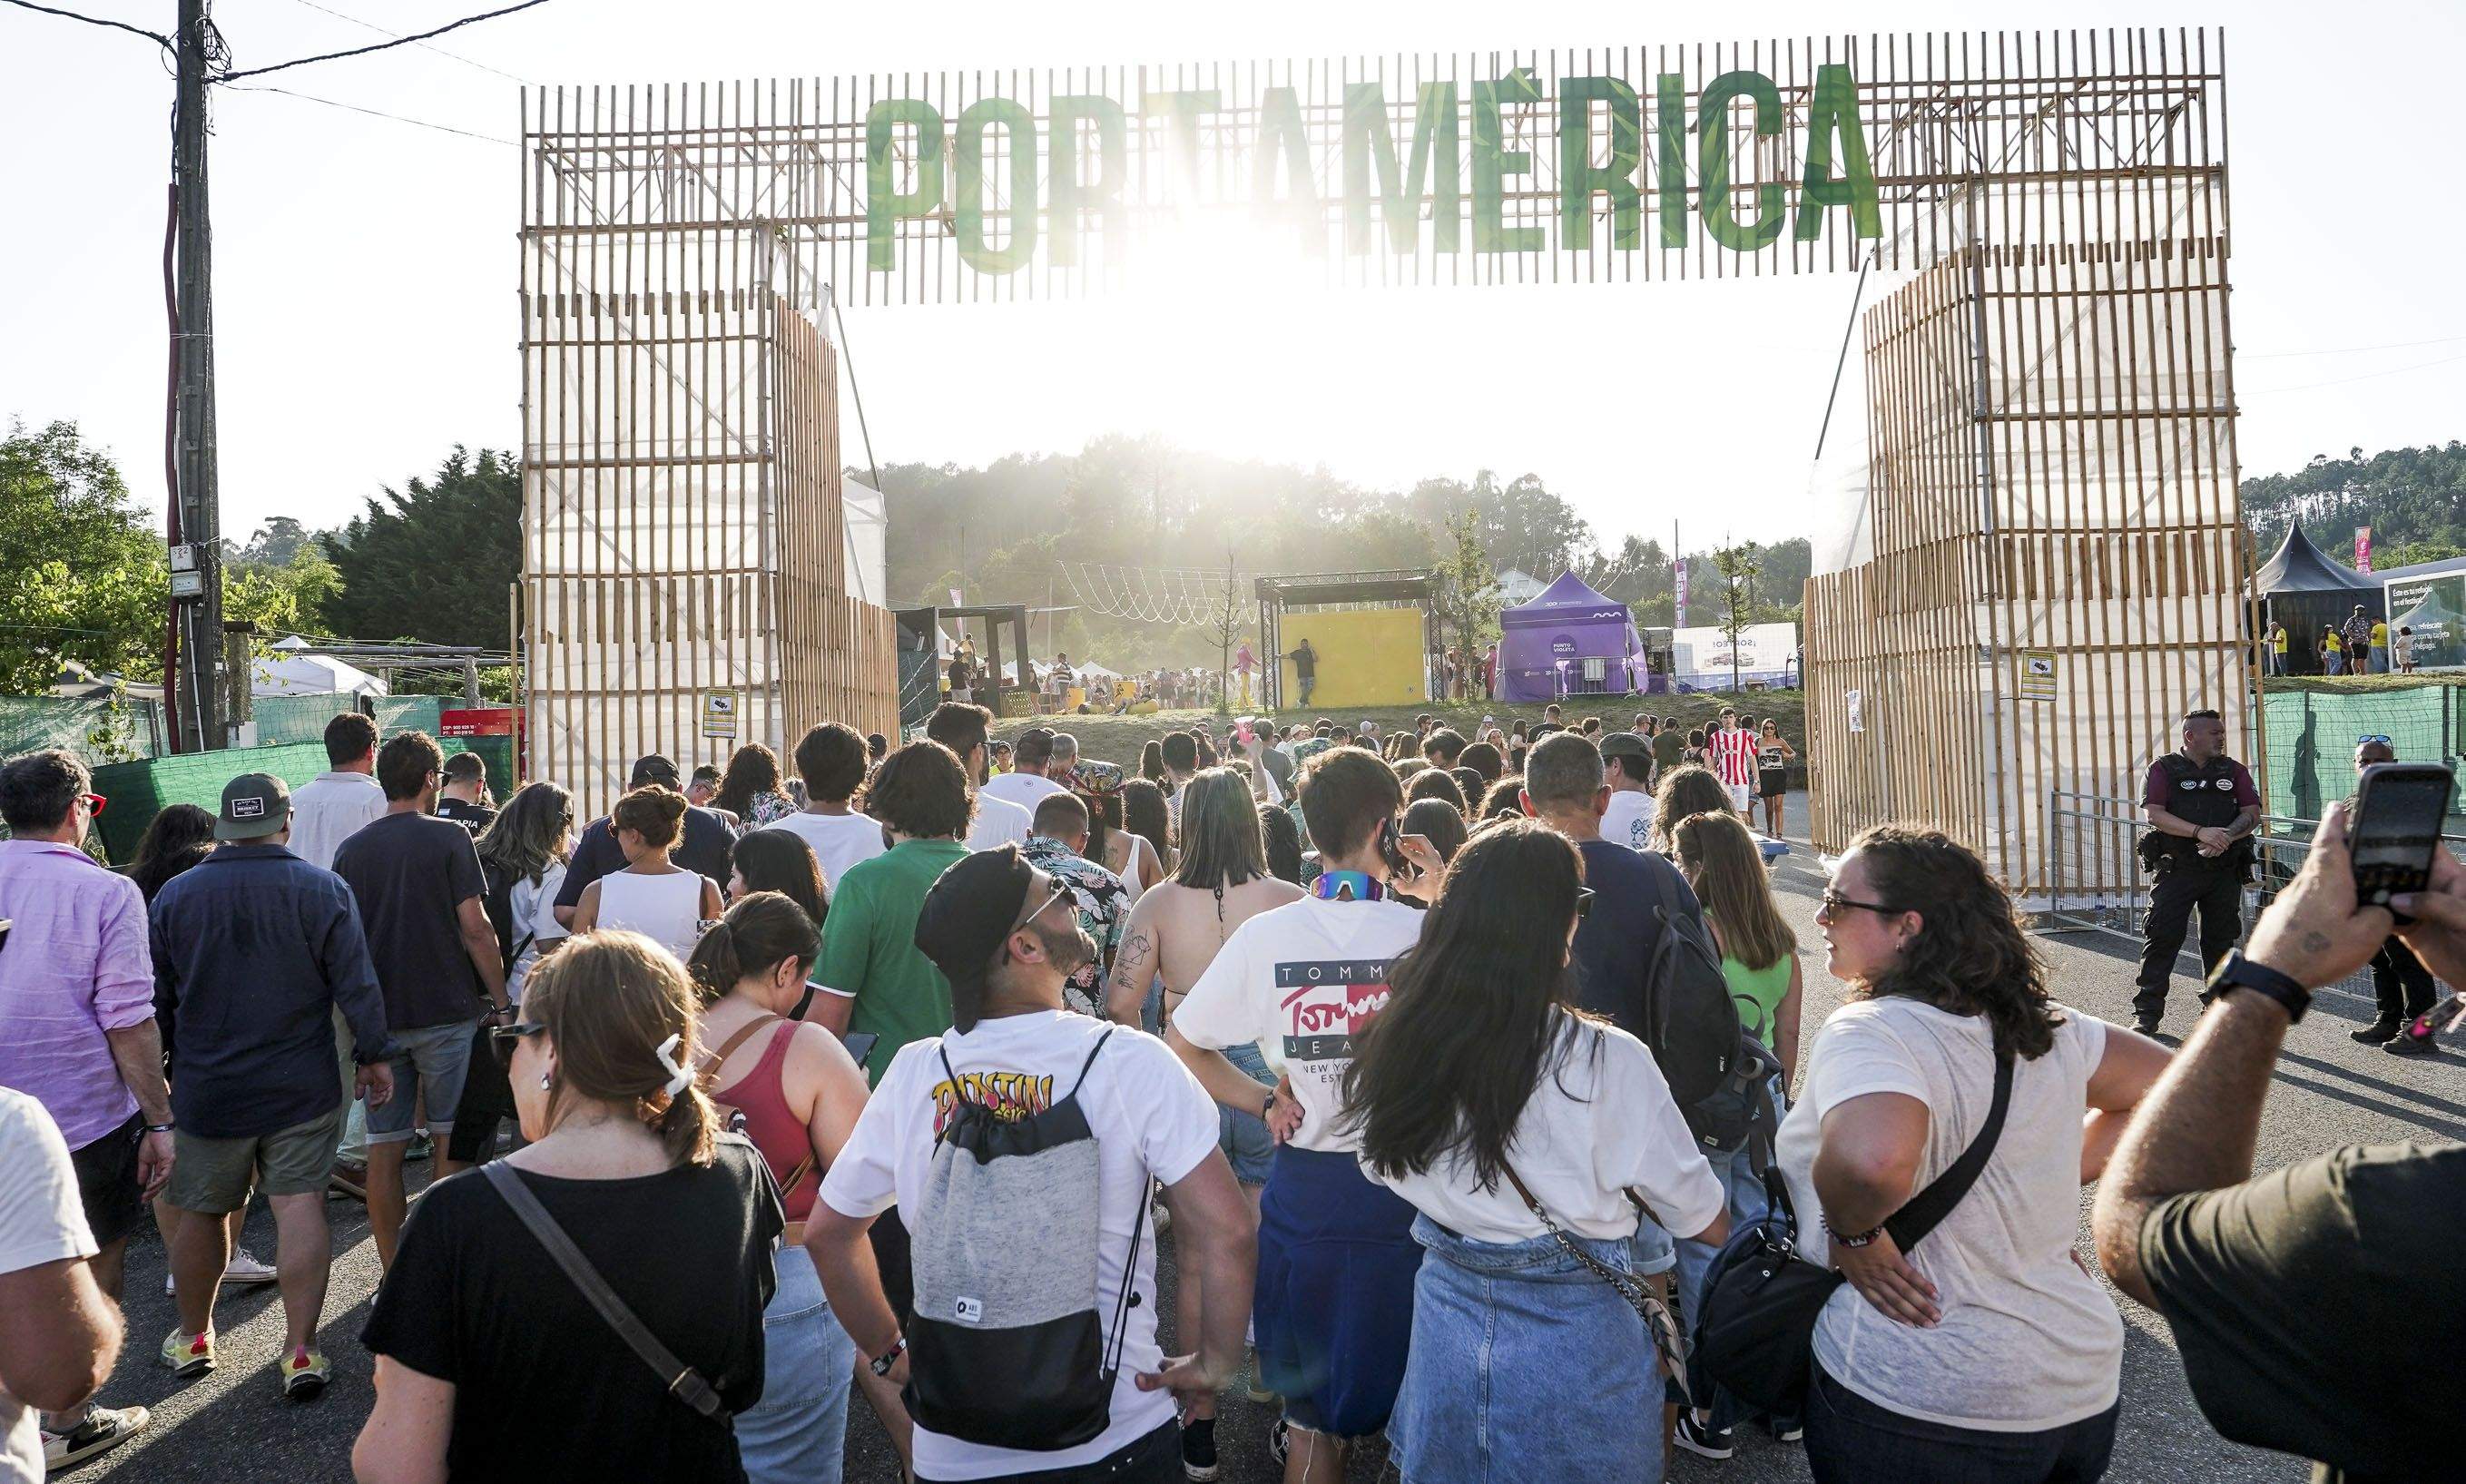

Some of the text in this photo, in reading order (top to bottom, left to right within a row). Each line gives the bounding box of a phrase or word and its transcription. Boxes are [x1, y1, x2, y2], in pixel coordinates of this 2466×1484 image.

[456, 819, 478, 829] APIA
[1282, 965, 1383, 981] TOMM
[1290, 1040, 1353, 1054] JEA
[1333, 1062, 1351, 1072] YO
